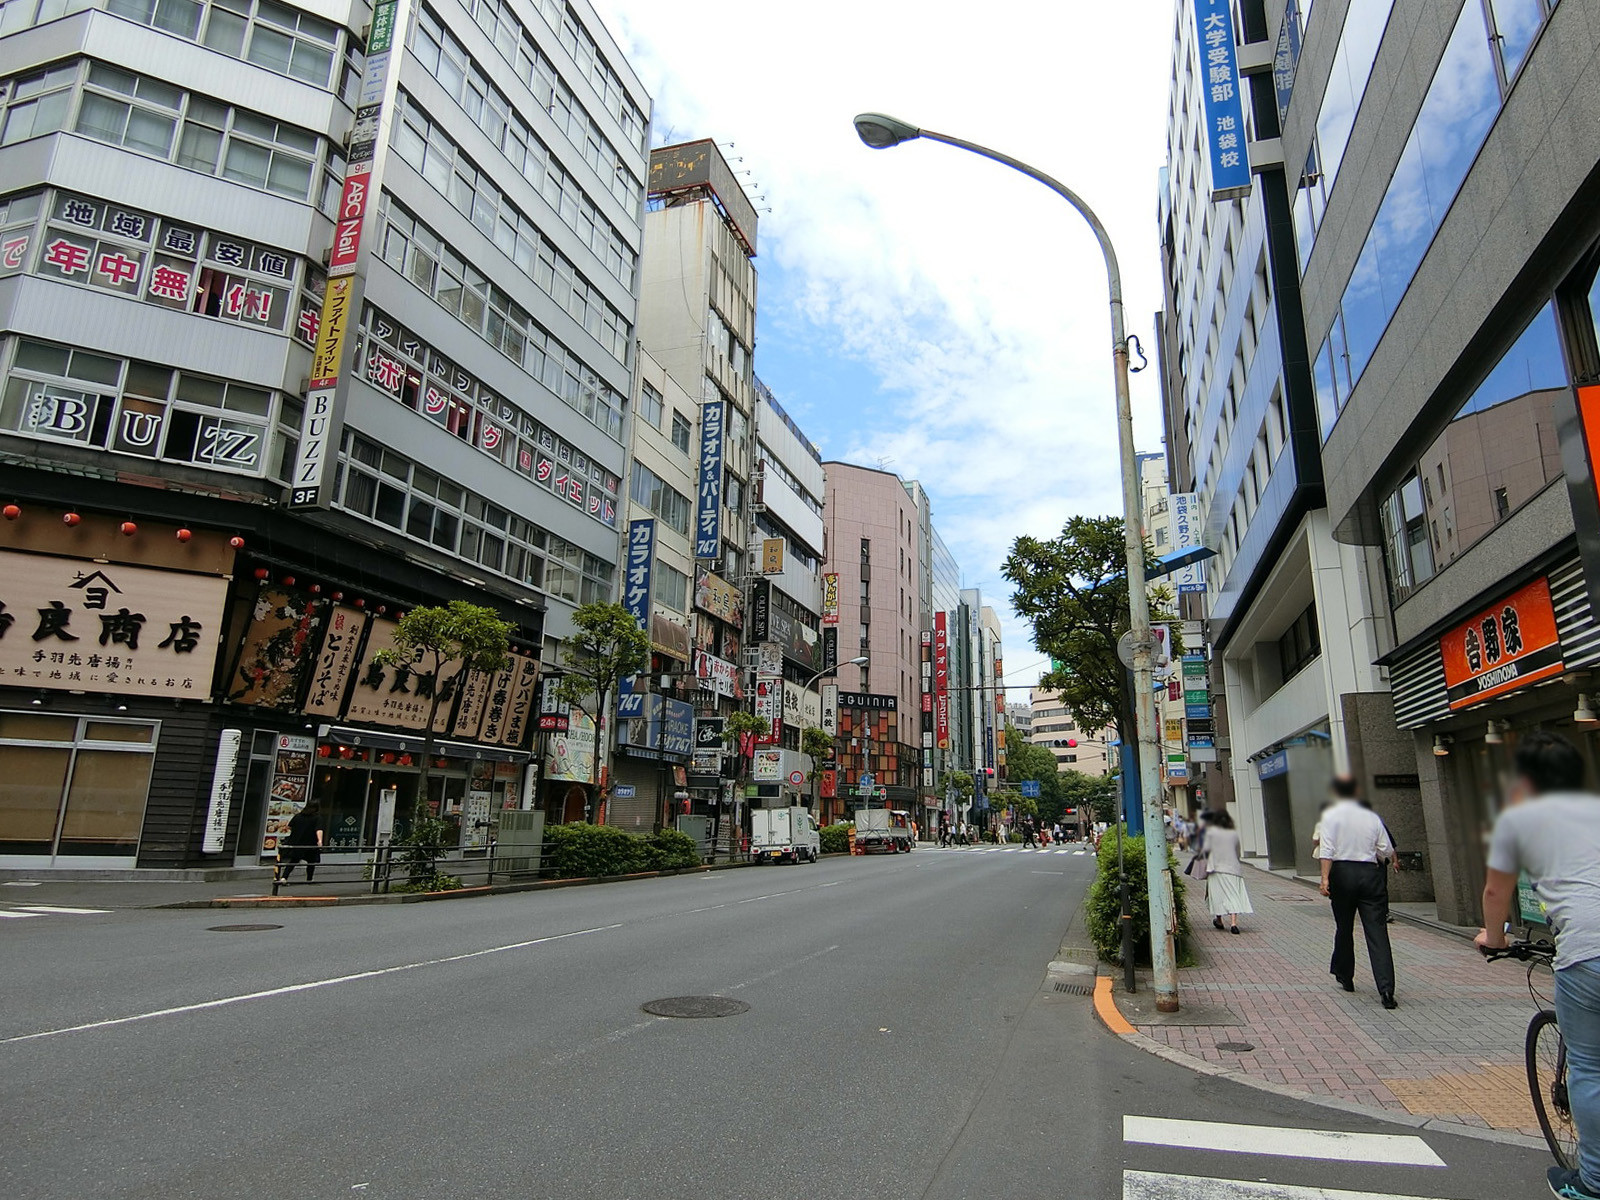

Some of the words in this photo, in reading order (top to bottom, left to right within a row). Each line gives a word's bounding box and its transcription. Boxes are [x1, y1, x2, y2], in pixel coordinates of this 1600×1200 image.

[371, 42, 384, 51] 6F
[1203, 12, 1234, 103] 大学受験部
[1216, 115, 1240, 168] 池袋校
[354, 163, 366, 174] 9F
[344, 181, 365, 219] ABC
[64, 200, 287, 278] 地域最安値
[337, 219, 360, 259] Nail
[321, 296, 346, 378] ファイトフィット
[318, 378, 330, 388] 4F
[300, 395, 328, 483] BUZZ
[536, 458, 615, 521] ダイエット
[701, 405, 721, 535] カラオケ&パーティ
[294, 489, 317, 504] 3F
[698, 539, 718, 554] 747
[757, 595, 767, 623] OLIVE
[311, 633, 342, 706] とりそば
[936, 629, 945, 678] カラオケ
[1476, 662, 1519, 691] YOSHINOYA
[618, 694, 643, 711] 747
[838, 694, 895, 708] EQUINIA
